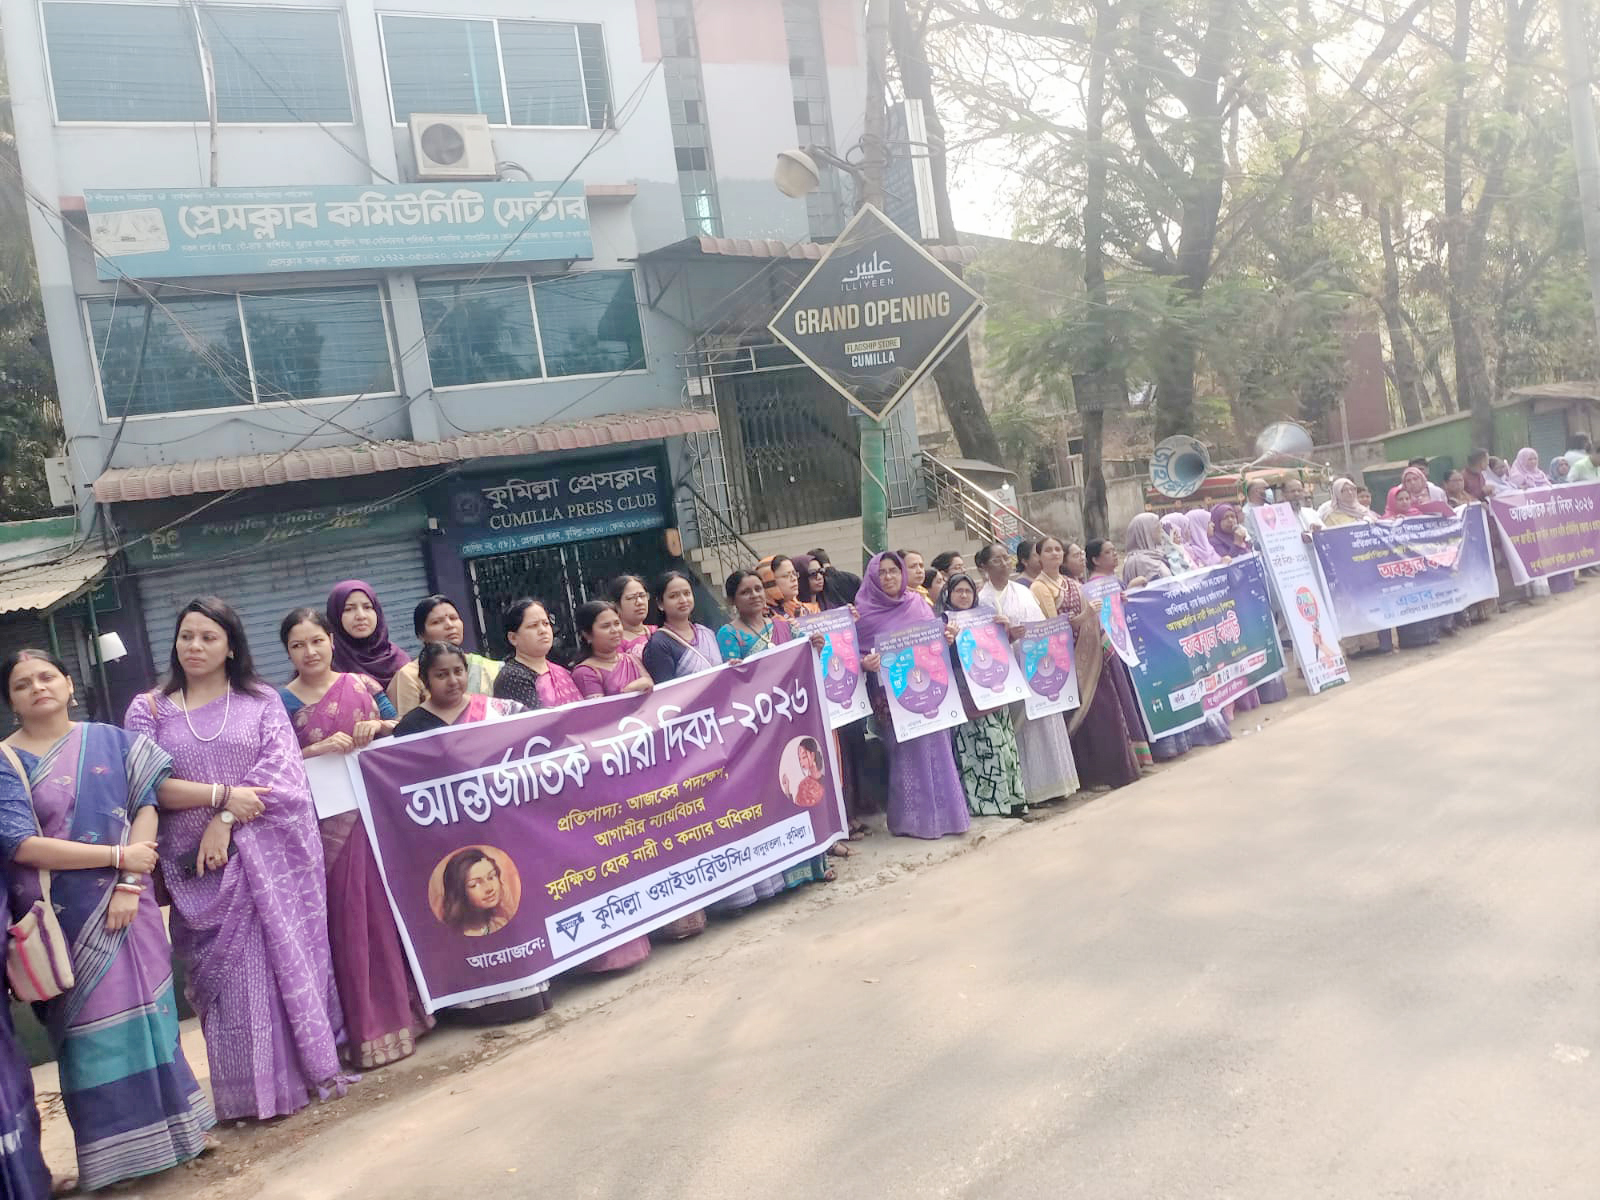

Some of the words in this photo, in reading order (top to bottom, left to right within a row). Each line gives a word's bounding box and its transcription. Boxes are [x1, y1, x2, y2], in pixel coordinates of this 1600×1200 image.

[178, 203, 318, 240] প্রেসক্লাব
[325, 189, 484, 227] কমিউনিটি
[494, 190, 587, 227] সেন্টার
[841, 277, 894, 292] ILLIYEEN
[794, 303, 860, 335] GRAND
[864, 291, 950, 327] OPENING
[846, 341, 877, 353] FLAGSHIP
[877, 338, 899, 350] STORE
[851, 350, 895, 368] CUMILLA
[481, 478, 560, 509] কুমিল্লা
[568, 466, 657, 494] প্রেসক্লাব
[489, 507, 564, 530] CUMILLA
[567, 499, 613, 519] PRESS
[617, 493, 657, 510] CLUB
[400, 735, 591, 827] আন্তর্জাতিক
[591, 716, 658, 777] নারী
[656, 679, 808, 761] দিবস-২০২৬
[557, 801, 623, 833] প্রতিপাদ্য:
[626, 783, 679, 810] আজকের
[594, 818, 646, 848] আগামীর
[649, 798, 706, 828] ন্যায়বিচার
[545, 866, 597, 901] সুরক্ষিত
[601, 853, 631, 879] হোক
[632, 836, 659, 863] নারী
[662, 837, 674, 851] ও
[675, 823, 715, 846] কন্যার
[715, 803, 763, 830] অধিকার
[465, 936, 546, 969] আয়োজনে:
[592, 890, 642, 930] কুমিল্লা
